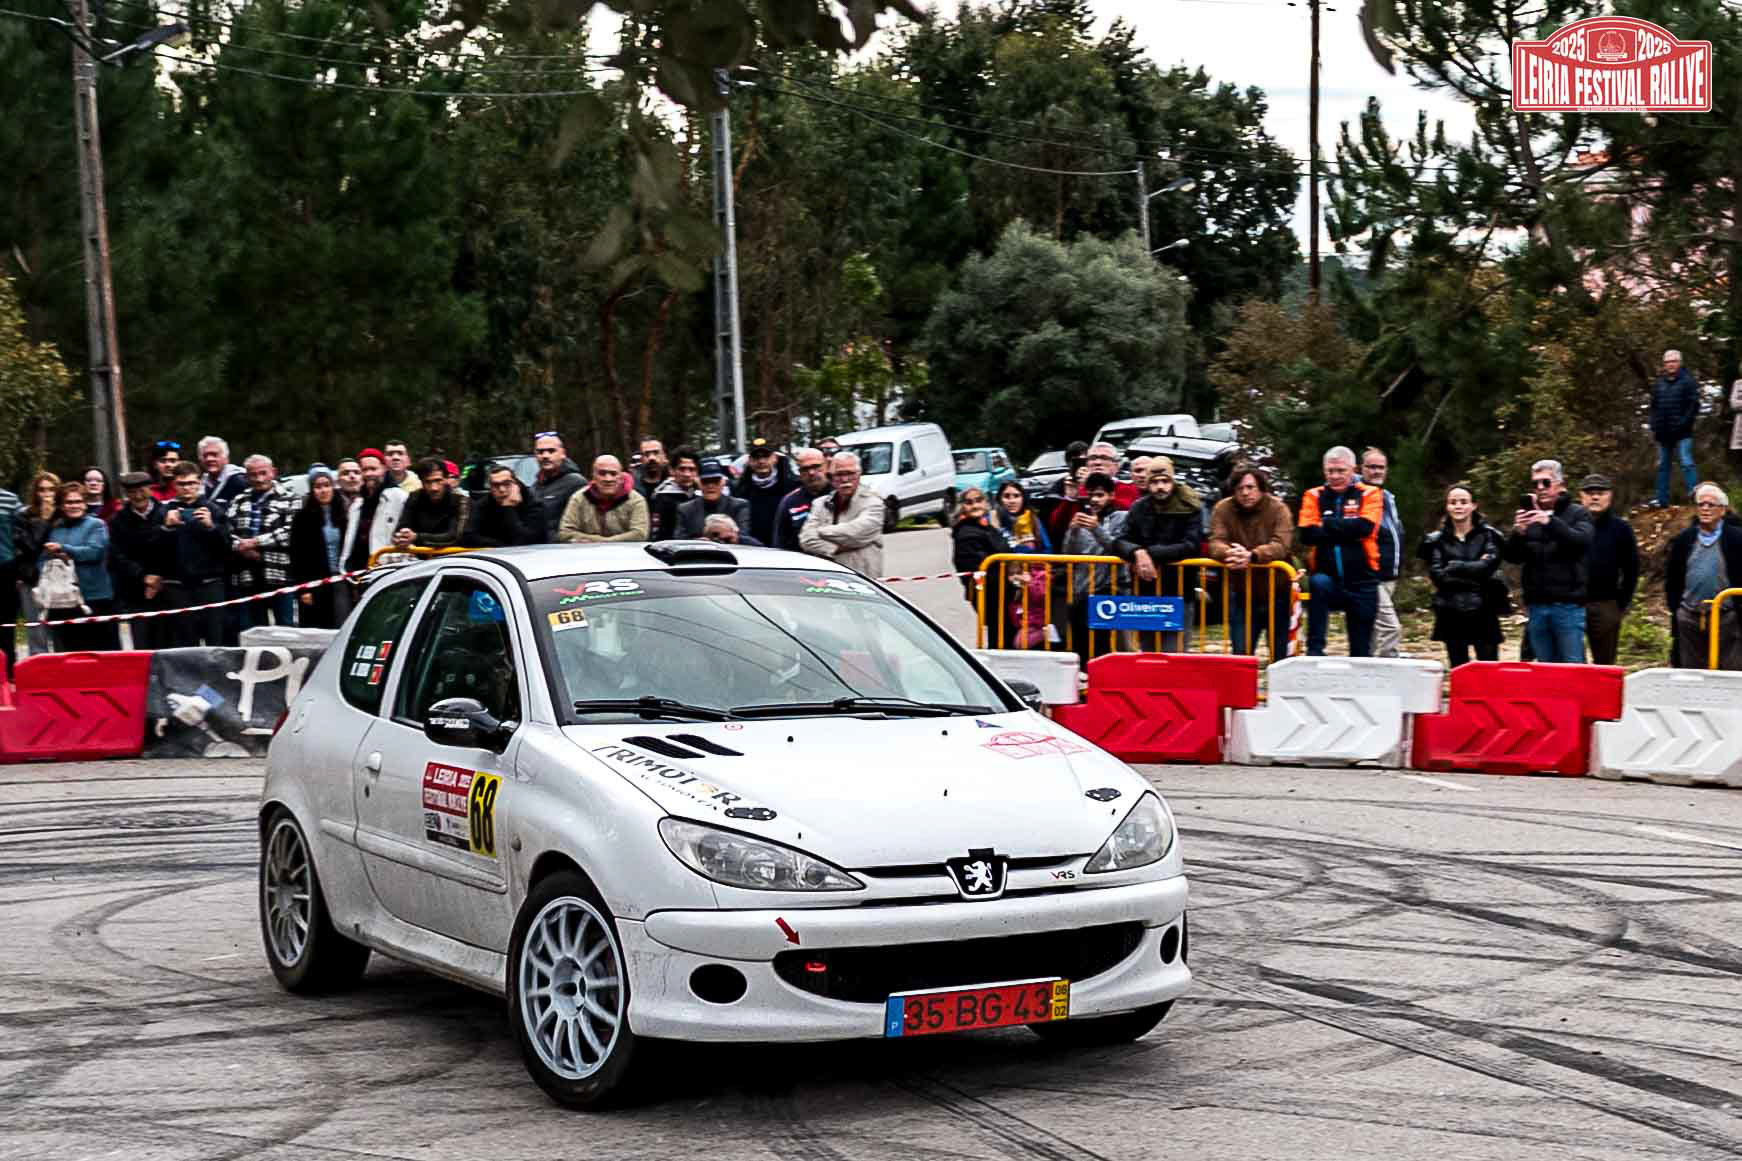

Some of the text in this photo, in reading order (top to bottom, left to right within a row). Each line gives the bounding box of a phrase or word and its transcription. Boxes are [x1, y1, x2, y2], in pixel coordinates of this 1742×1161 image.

[558, 610, 585, 625] 68
[470, 776, 498, 854] 68
[1050, 870, 1076, 879] VRS
[891, 1021, 899, 1031] P
